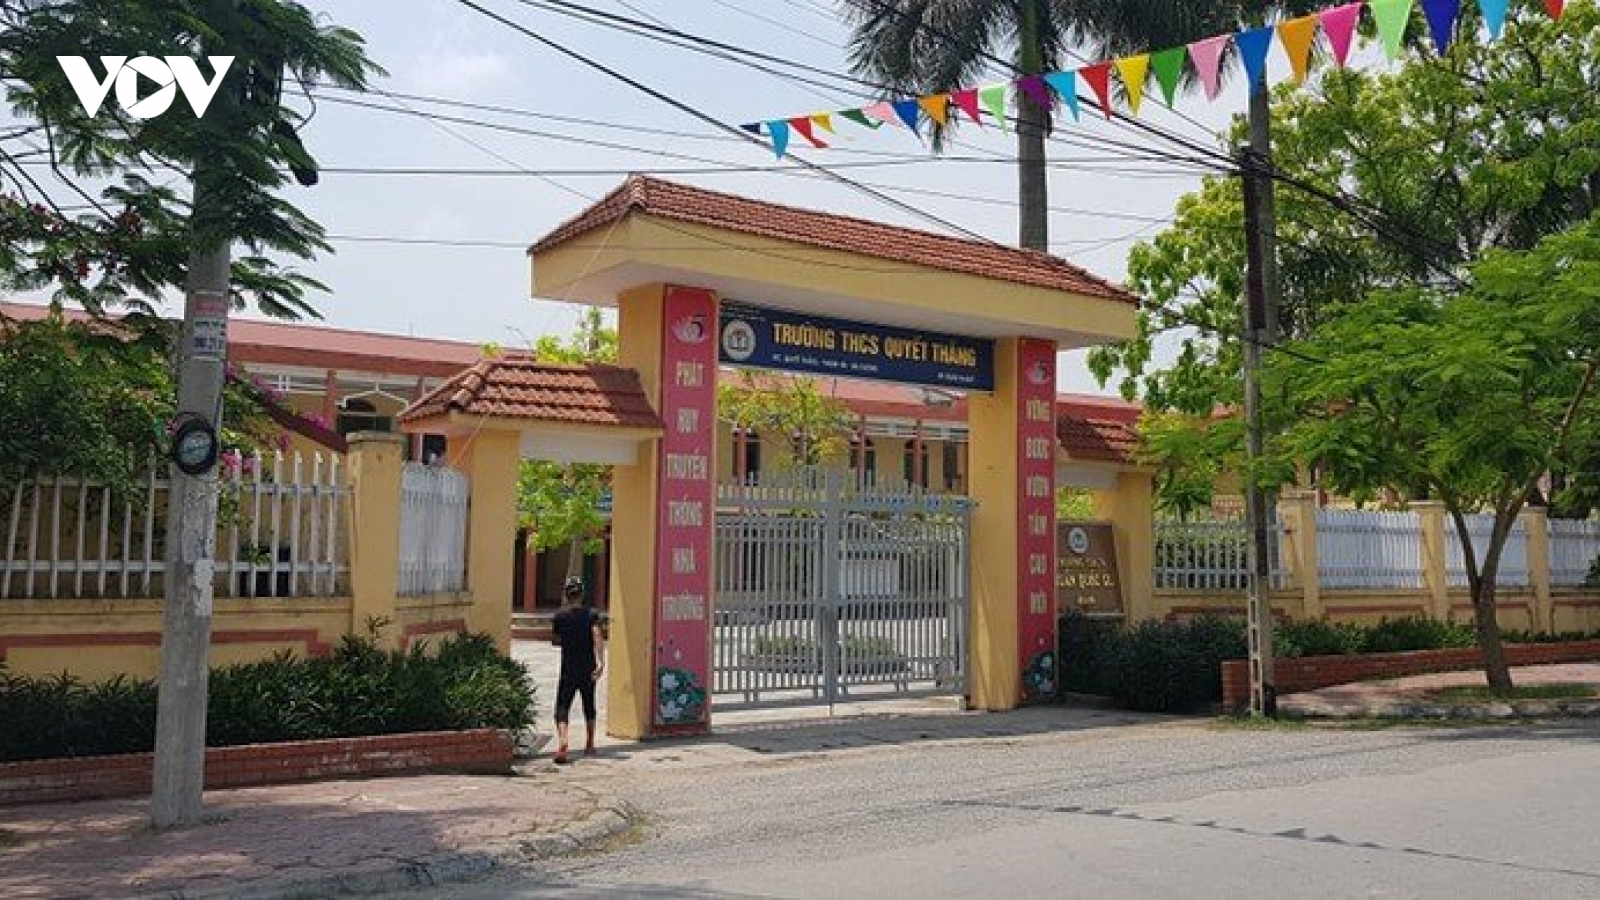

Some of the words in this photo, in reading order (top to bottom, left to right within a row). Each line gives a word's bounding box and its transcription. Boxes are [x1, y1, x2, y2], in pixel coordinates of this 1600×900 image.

[773, 321, 835, 349] TRƯỜNG
[841, 331, 879, 355] THCS
[884, 335, 928, 361] QUYẾT
[931, 342, 976, 367] THẮNG
[676, 359, 703, 386] PHÁT
[677, 407, 700, 433] HUY
